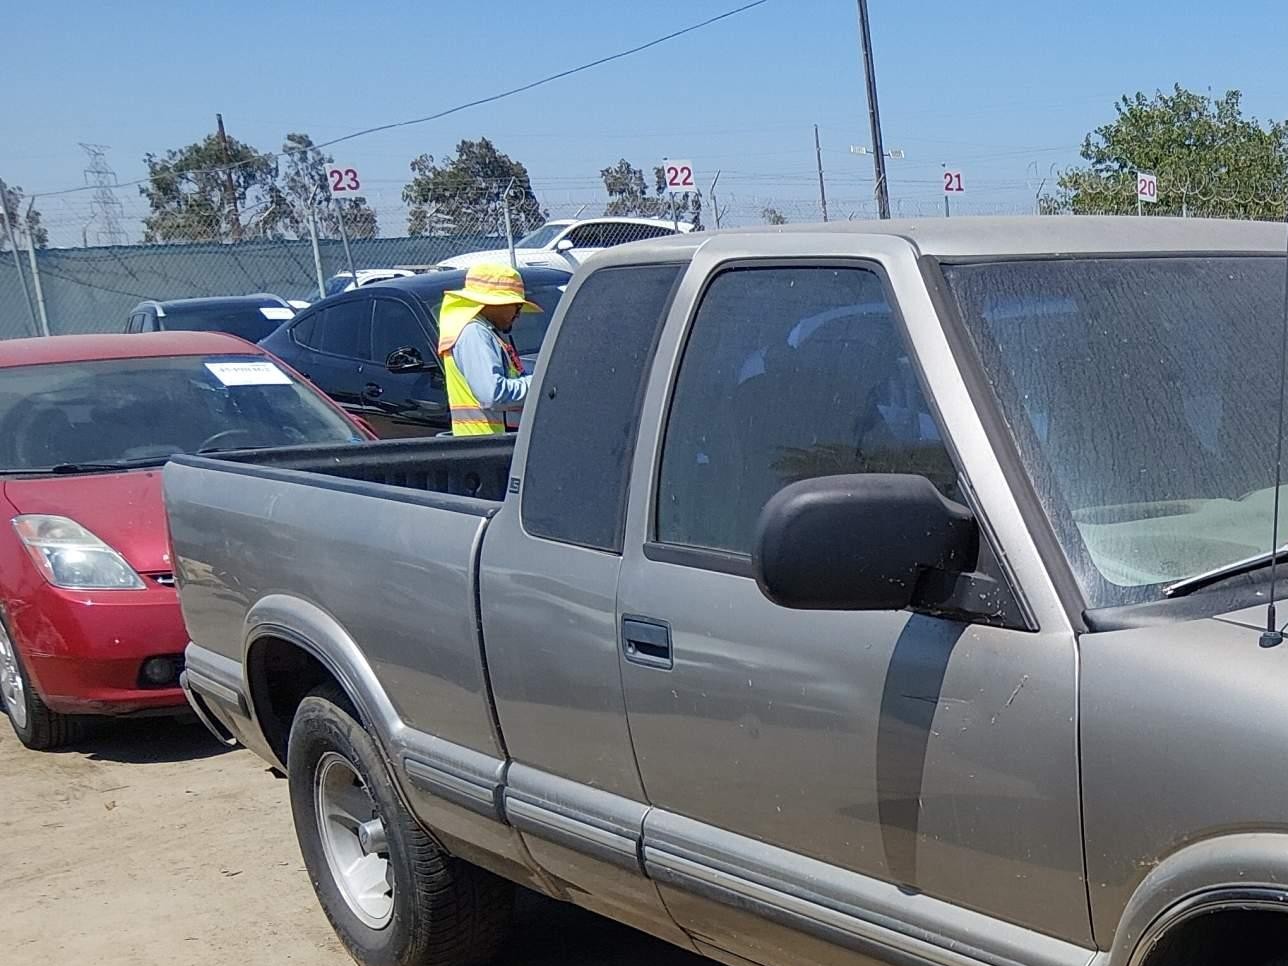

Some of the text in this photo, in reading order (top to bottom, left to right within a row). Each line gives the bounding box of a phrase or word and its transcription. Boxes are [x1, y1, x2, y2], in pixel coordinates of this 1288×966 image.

[330, 169, 360, 191] 23
[667, 166, 693, 186] 22
[944, 173, 964, 191] 21
[1139, 179, 1156, 197] 20
